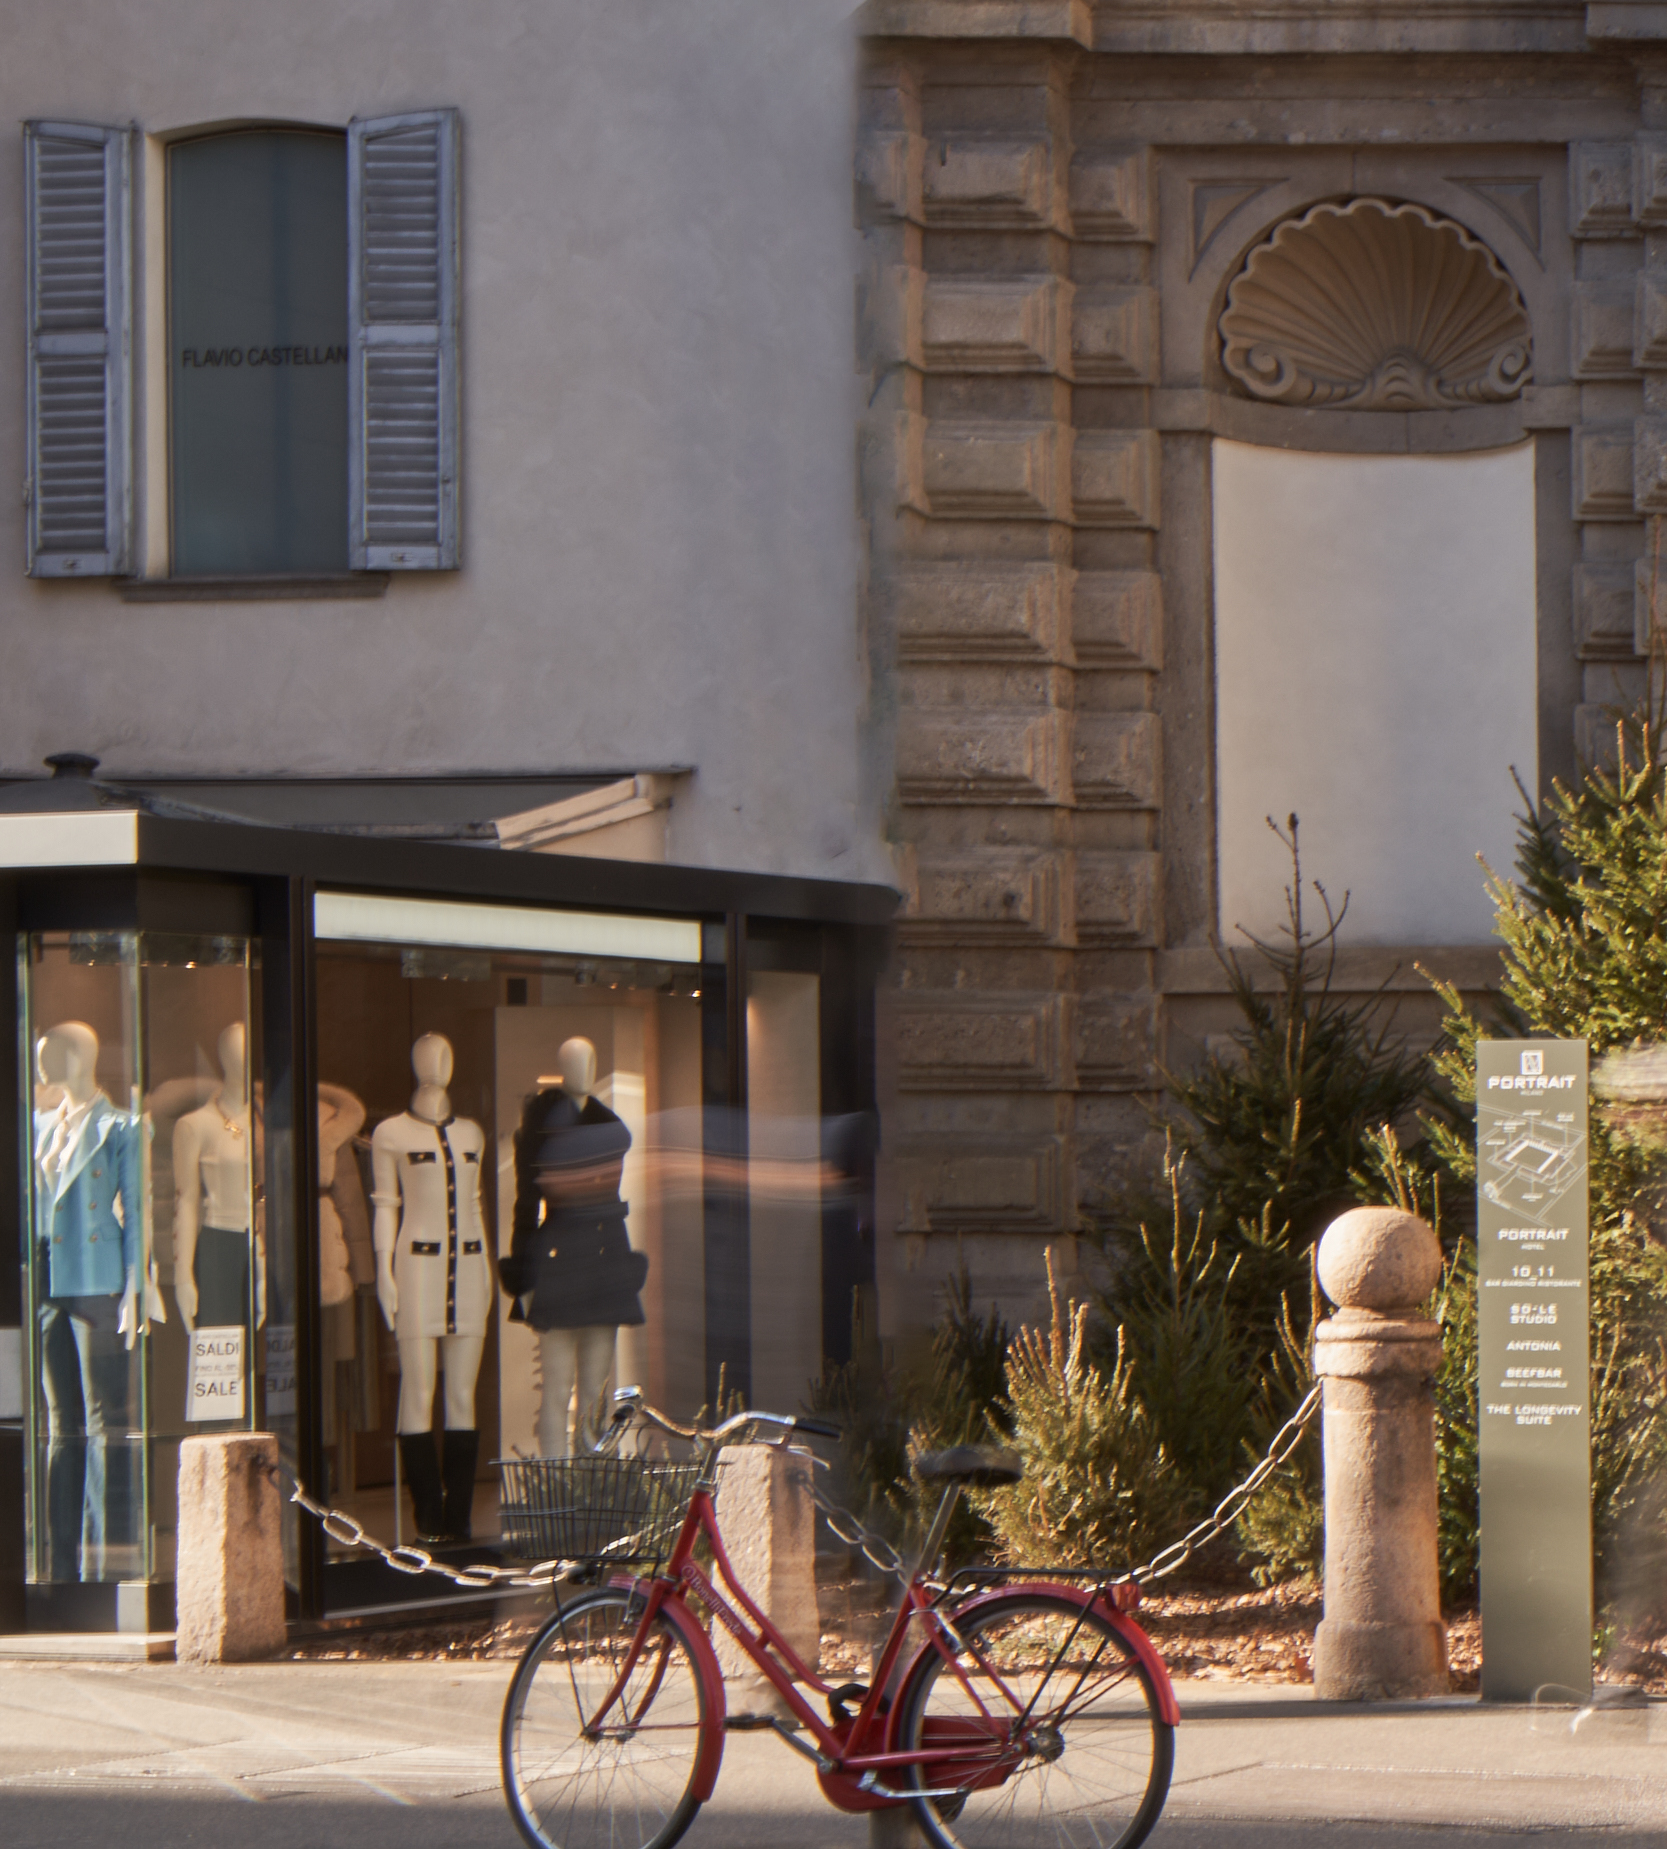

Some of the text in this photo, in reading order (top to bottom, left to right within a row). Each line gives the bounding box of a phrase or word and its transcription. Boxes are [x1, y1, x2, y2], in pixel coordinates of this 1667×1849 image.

[182, 348, 243, 368] FLAVIO
[1488, 1075, 1576, 1089] PORTRAIT
[1498, 1229, 1568, 1240] PORTRAIT
[1510, 1314, 1557, 1325] STUDIO
[195, 1342, 239, 1357] SALDI
[1506, 1339, 1562, 1351] ANTONIA
[1505, 1367, 1562, 1379] BEEFBAR
[194, 1380, 238, 1398] SALE
[1485, 1403, 1582, 1416] THE LONGEVITY
[1516, 1415, 1553, 1426] SUITE
